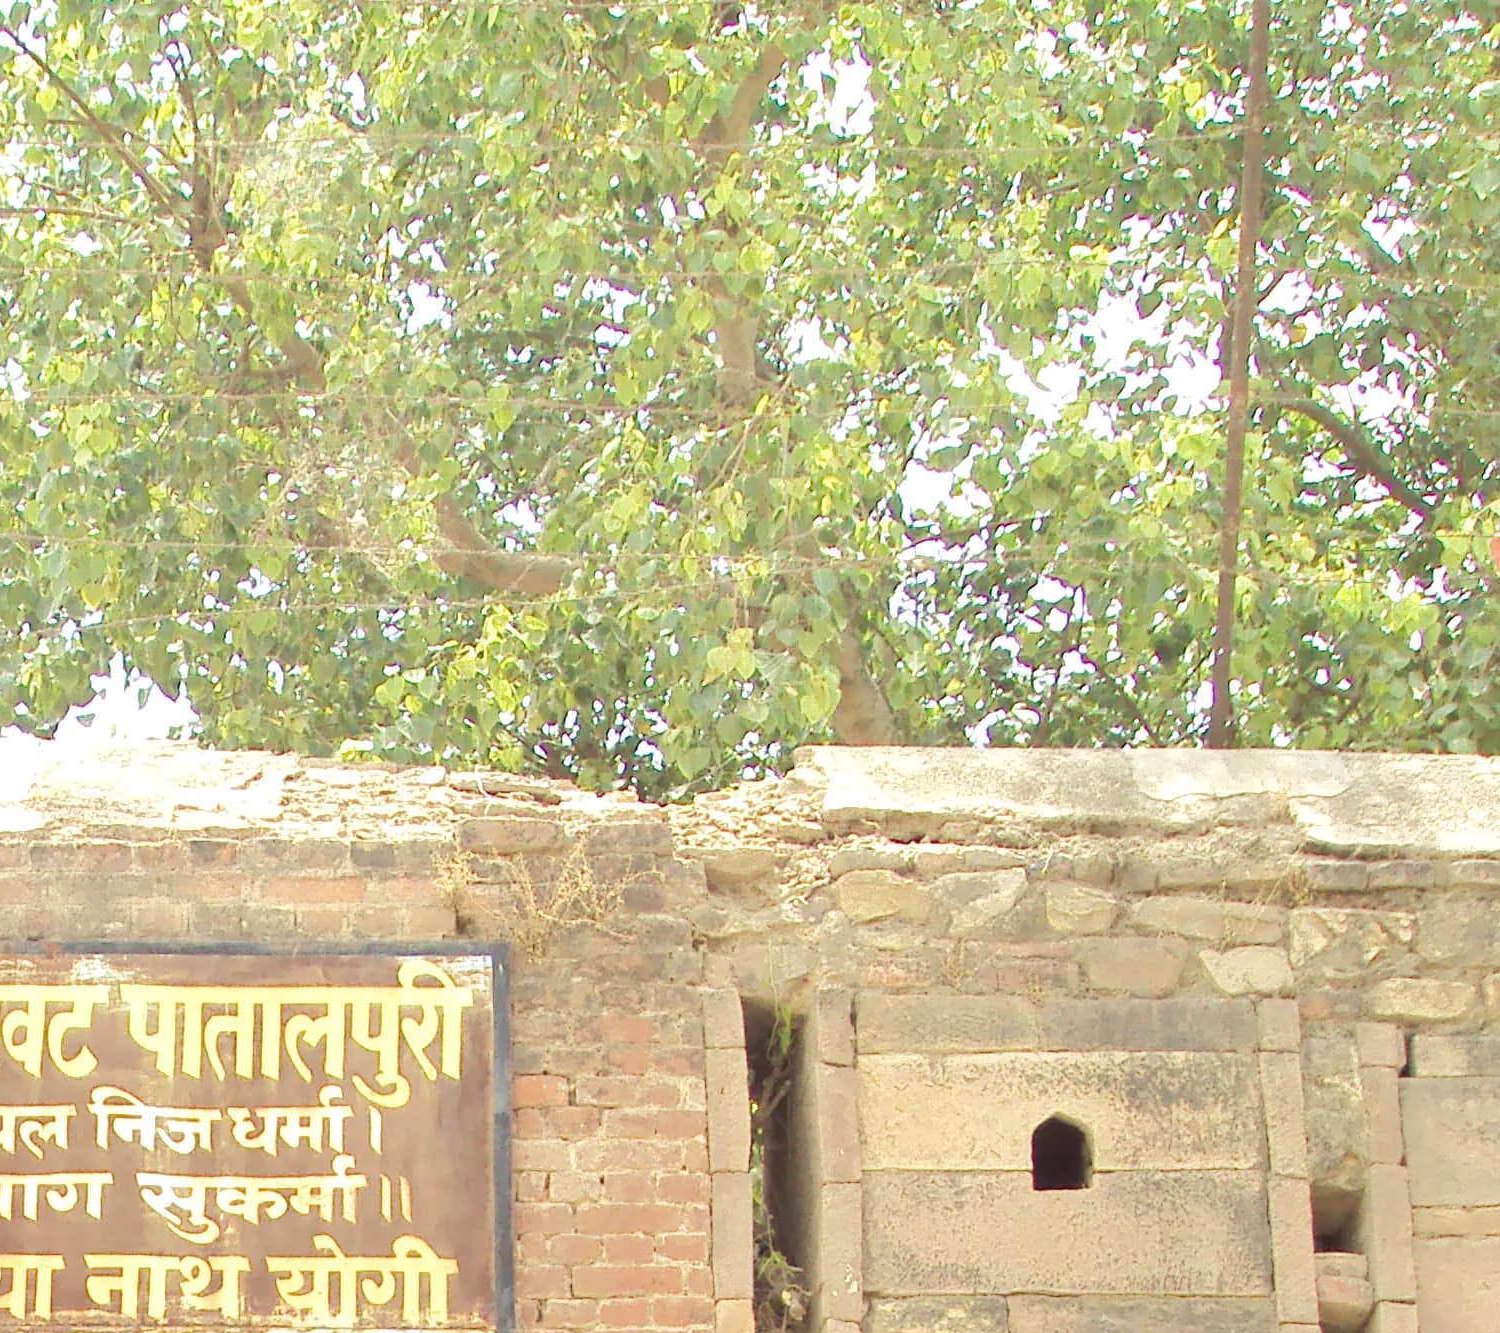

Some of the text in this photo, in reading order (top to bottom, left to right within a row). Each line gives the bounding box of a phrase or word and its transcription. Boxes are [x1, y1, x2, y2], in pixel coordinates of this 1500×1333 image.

[121, 959, 473, 1108] पातालपुरी
[88, 1086, 221, 1154] निज
[85, 1253, 251, 1319] नाथ
[266, 1235, 459, 1326] योगी
